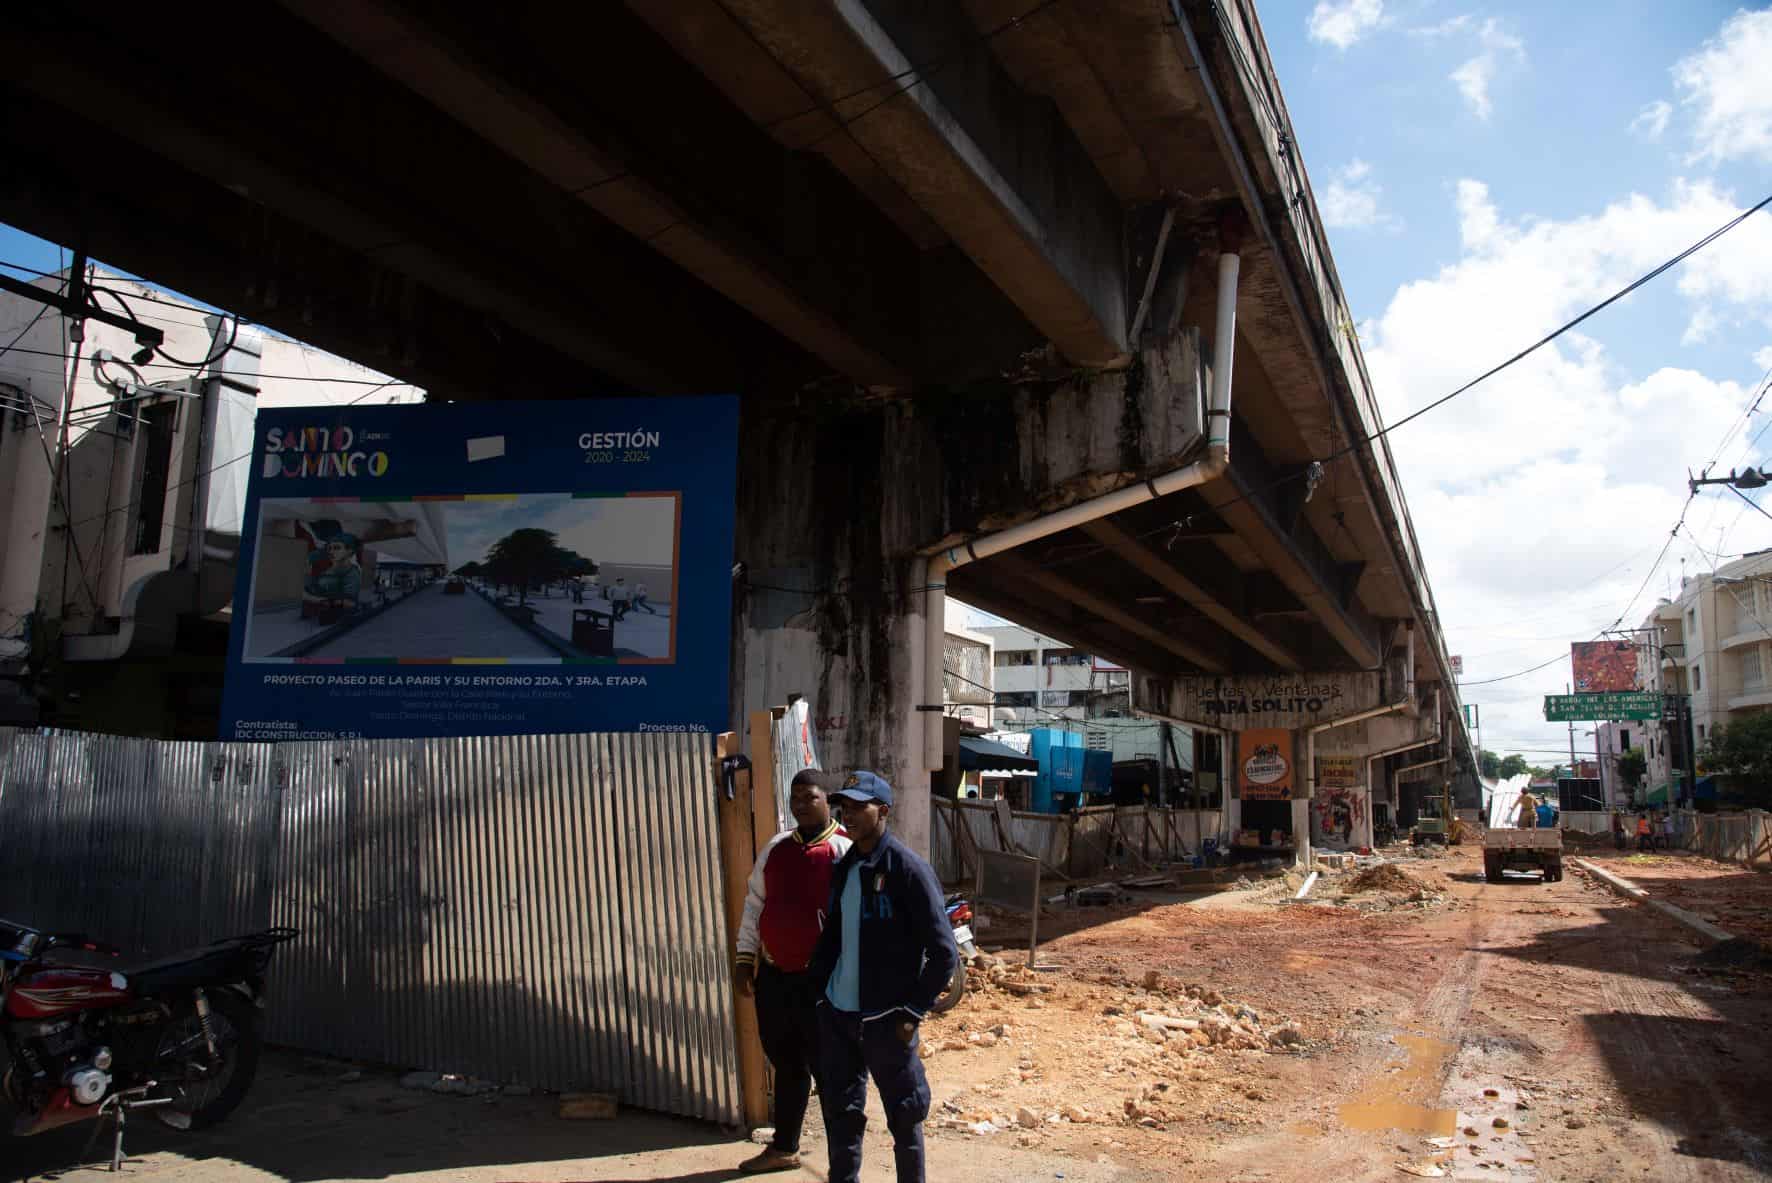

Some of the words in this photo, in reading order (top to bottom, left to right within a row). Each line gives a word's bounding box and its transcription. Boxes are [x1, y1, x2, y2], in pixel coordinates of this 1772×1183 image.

[265, 425, 354, 452] SANTO
[578, 426, 660, 449] GESTIÓN
[584, 451, 613, 463] 2020
[623, 451, 650, 463] 2024
[263, 675, 325, 686] PROYECTO
[327, 675, 367, 686] PASEO
[369, 676, 385, 686] DE
[389, 676, 404, 686] LA
[406, 676, 441, 686] PARIS
[443, 676, 452, 686] Y
[454, 676, 470, 686] SU
[473, 676, 533, 687] ENTORNO
[534, 676, 563, 687] 2DA.
[565, 676, 574, 687] Y
[576, 676, 603, 687] 3RA.
[606, 676, 647, 687] ETAPA
[1263, 680, 1339, 698] Ventanas
[235, 720, 298, 729] Contratista:
[639, 722, 686, 733] Proceso
[689, 722, 710, 733] No.
